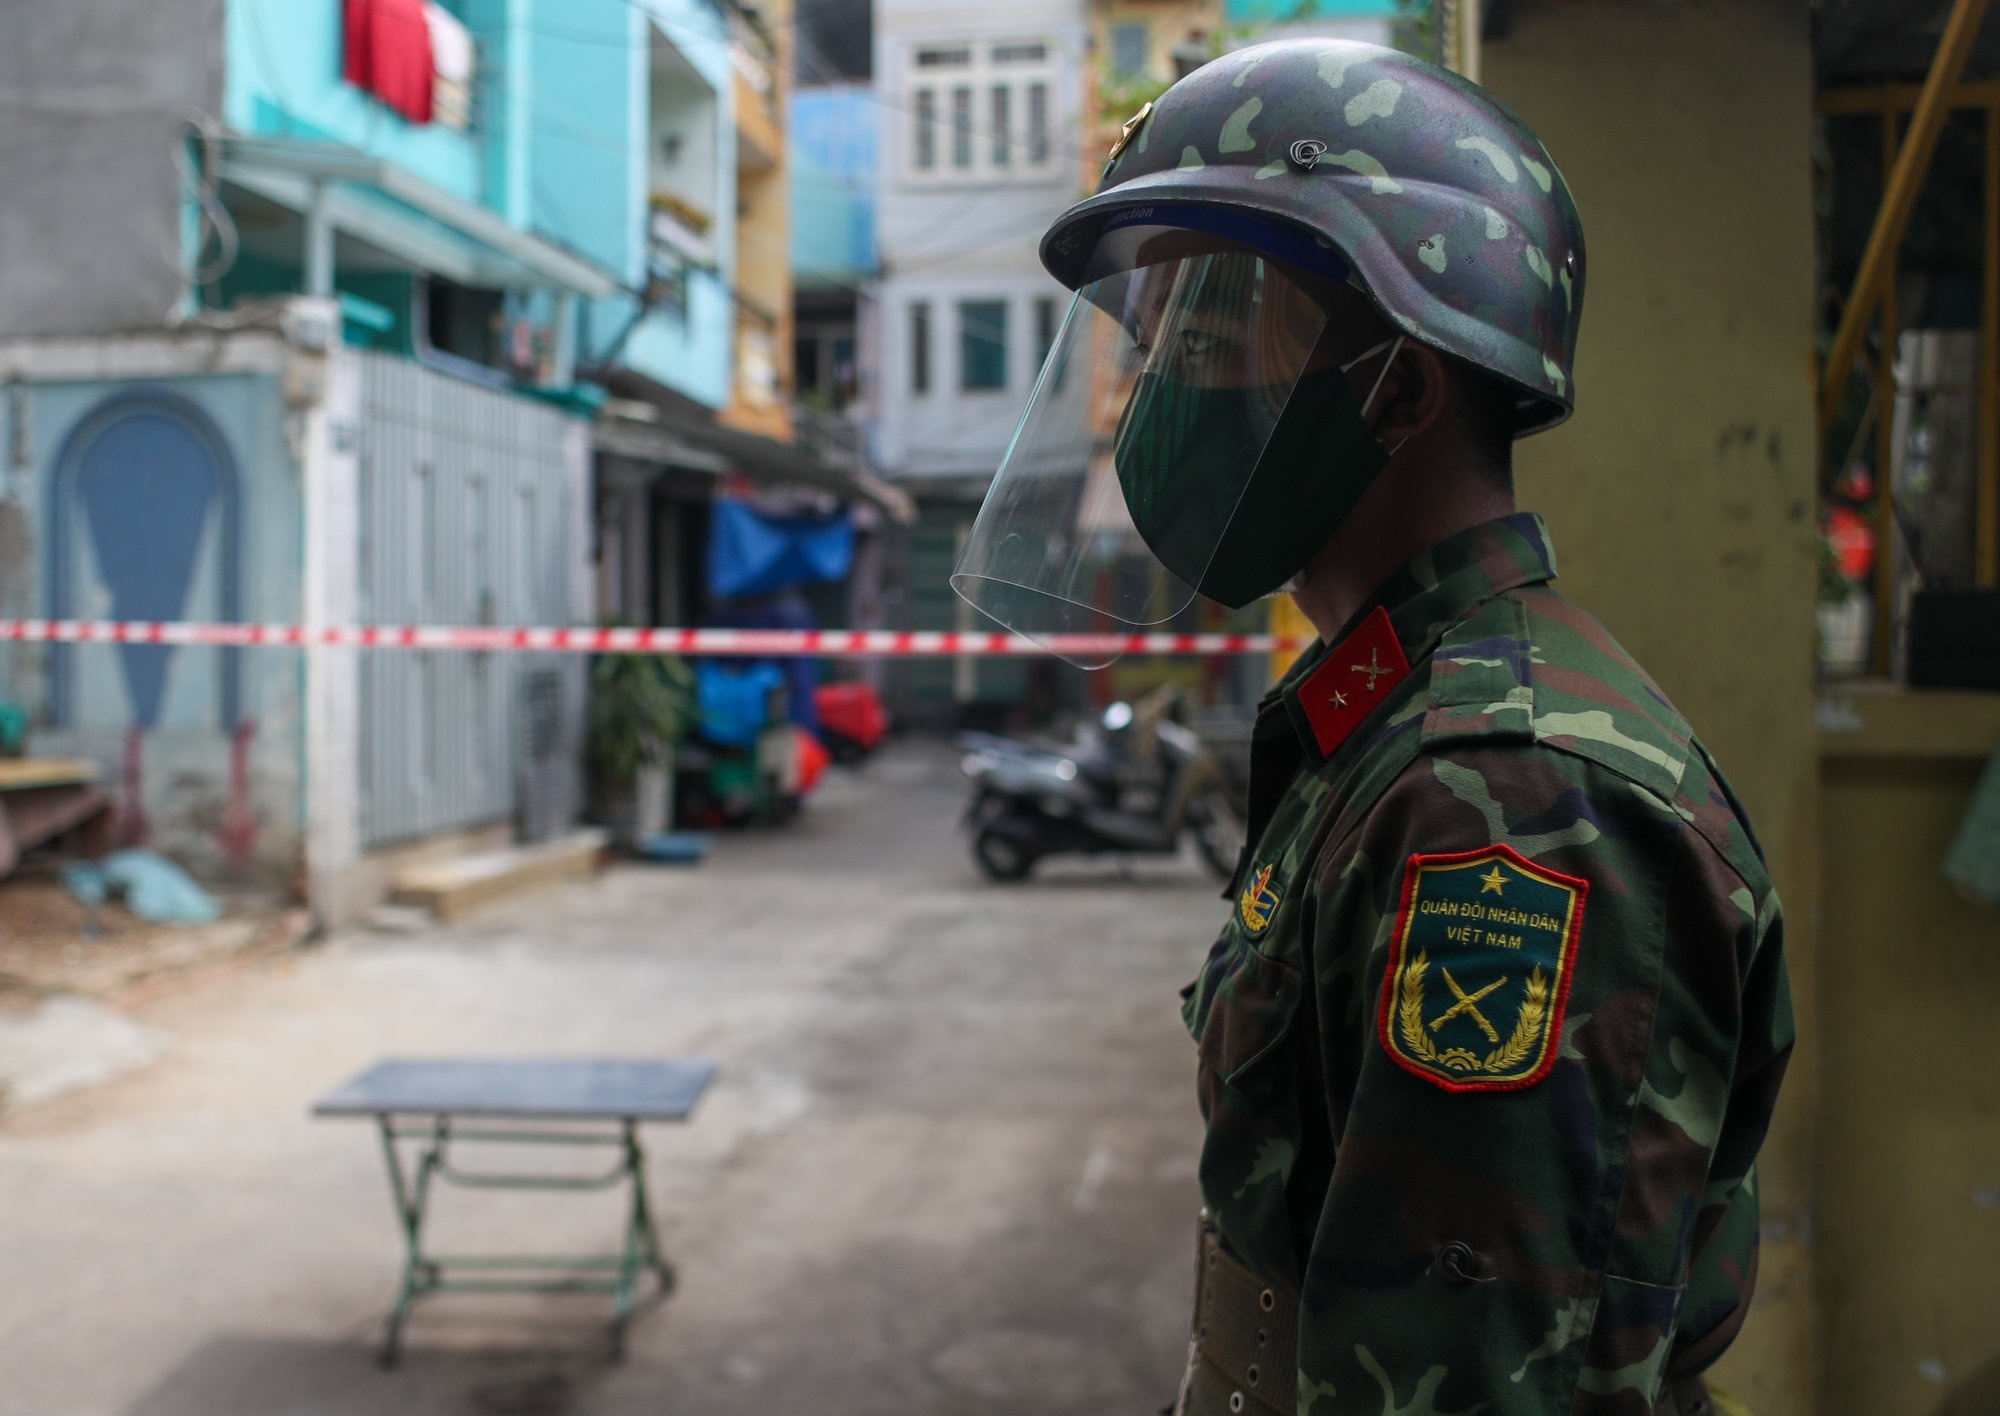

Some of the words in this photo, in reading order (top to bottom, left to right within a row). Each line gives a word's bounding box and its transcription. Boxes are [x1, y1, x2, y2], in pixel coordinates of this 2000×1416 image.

[1420, 898, 1457, 915] QUÂN
[1460, 901, 1486, 921] ĐỘI
[1487, 907, 1527, 926] NHÂN
[1529, 912, 1560, 932] DÂN
[1447, 924, 1483, 945] VIỆT
[1486, 932, 1522, 949] NAM
